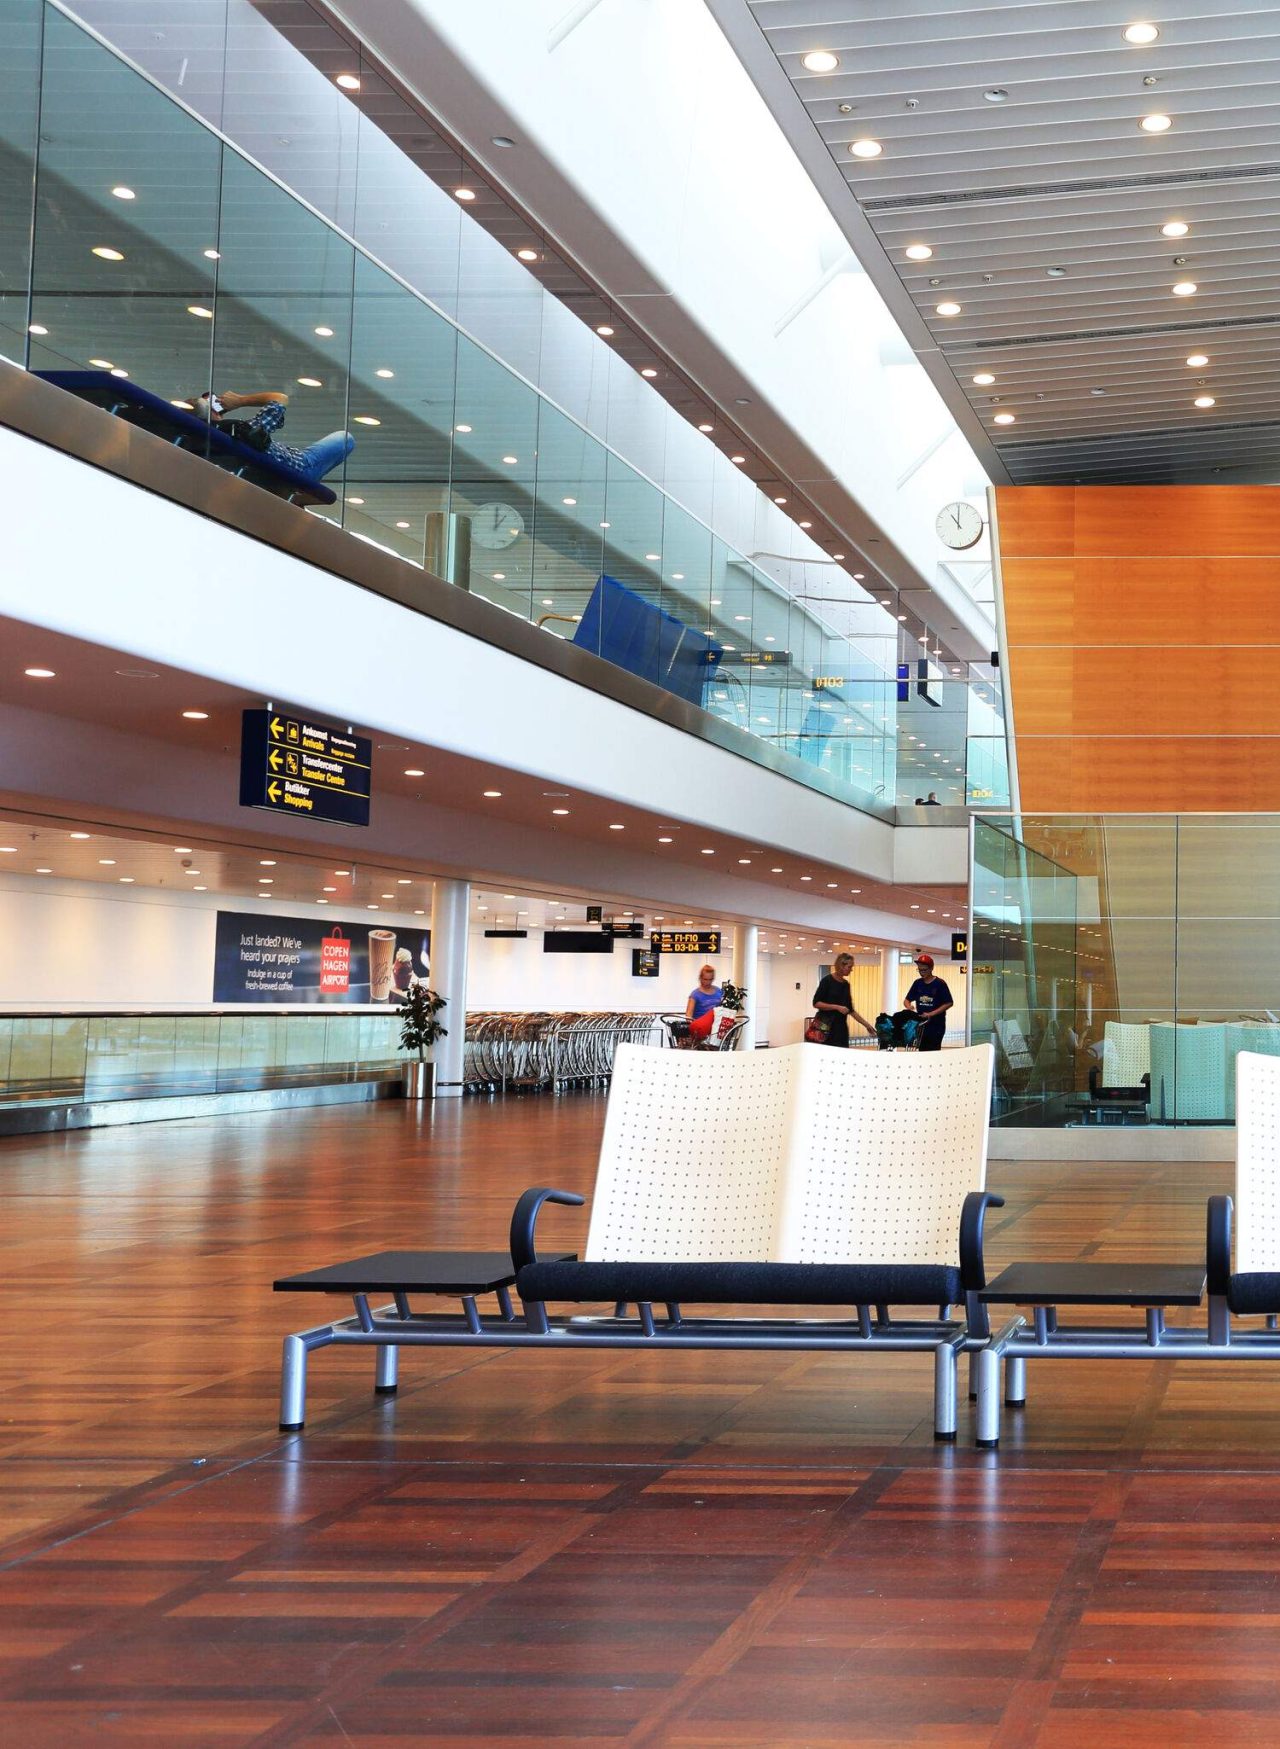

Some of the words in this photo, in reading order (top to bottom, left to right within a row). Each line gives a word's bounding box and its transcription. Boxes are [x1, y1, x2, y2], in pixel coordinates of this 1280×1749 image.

[302, 736, 325, 751] Arrivals
[302, 754, 344, 773] Transfercenter
[302, 766, 326, 781] Transfer
[326, 773, 346, 786] Centre
[285, 781, 310, 796] Butikker
[284, 793, 313, 810] Shopping
[240, 934, 254, 946] Just
[255, 934, 281, 948] landed?
[282, 936, 302, 949] We've
[674, 933, 699, 942] F1-F10
[323, 945, 349, 958] COPEN
[674, 943, 700, 952] D3-D4
[240, 949, 261, 962] heard
[261, 952, 277, 965] your
[277, 953, 300, 966] prayers
[323, 959, 348, 971] HAGEN
[247, 969, 267, 980] Indulge
[267, 969, 272, 978] in
[276, 971, 287, 981] cup
[287, 969, 293, 979] of
[322, 974, 349, 986] AIRPORT
[245, 980, 279, 991] fresh-brewed
[278, 981, 294, 991] coffee
